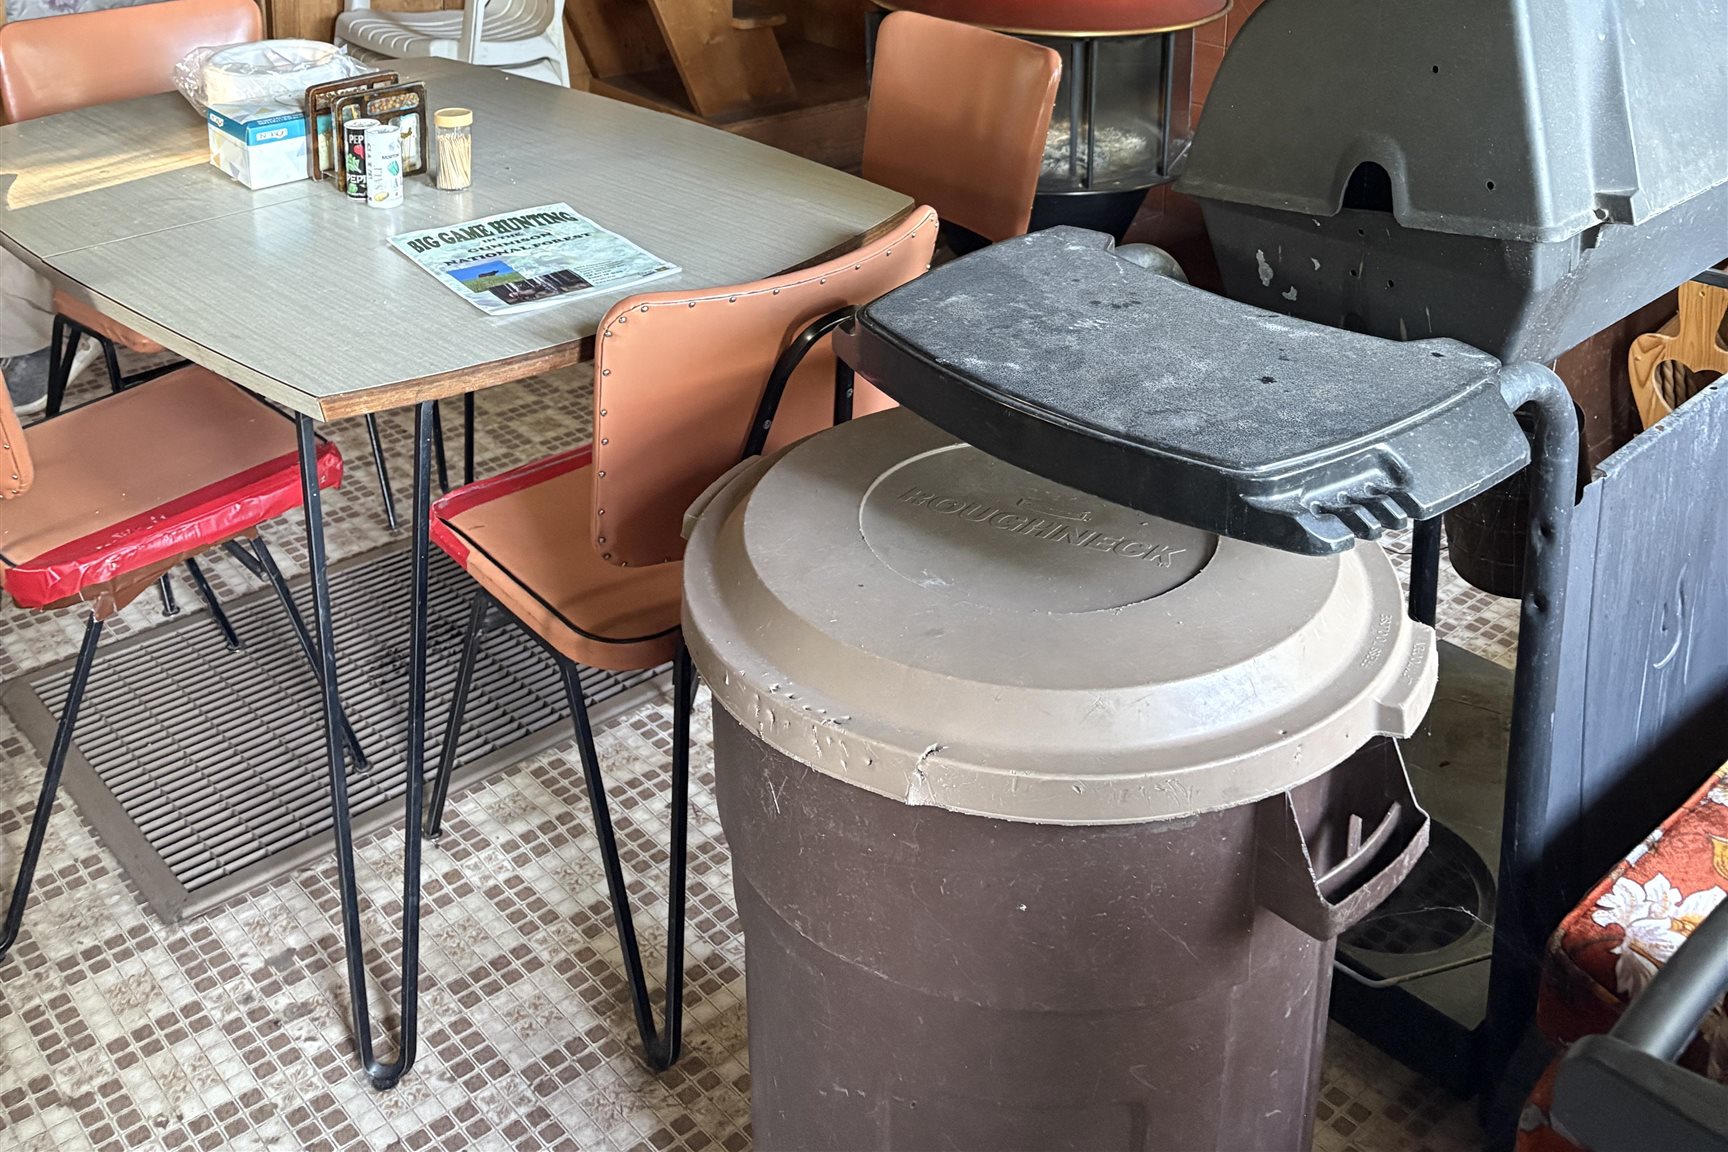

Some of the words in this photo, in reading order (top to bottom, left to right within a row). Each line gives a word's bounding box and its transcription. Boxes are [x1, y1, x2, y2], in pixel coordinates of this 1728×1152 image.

[349, 134, 364, 144] PEP
[346, 173, 367, 184] PEP
[407, 234, 440, 254] BIG
[438, 222, 494, 243] GAME
[493, 210, 579, 234] HUNTING
[467, 231, 553, 254] GUNNISON
[482, 236, 497, 244] IN
[500, 231, 522, 241] THE
[443, 245, 532, 267] NATIONAL
[533, 232, 593, 249] FOREST
[899, 486, 1188, 569] ROUGHNECK
